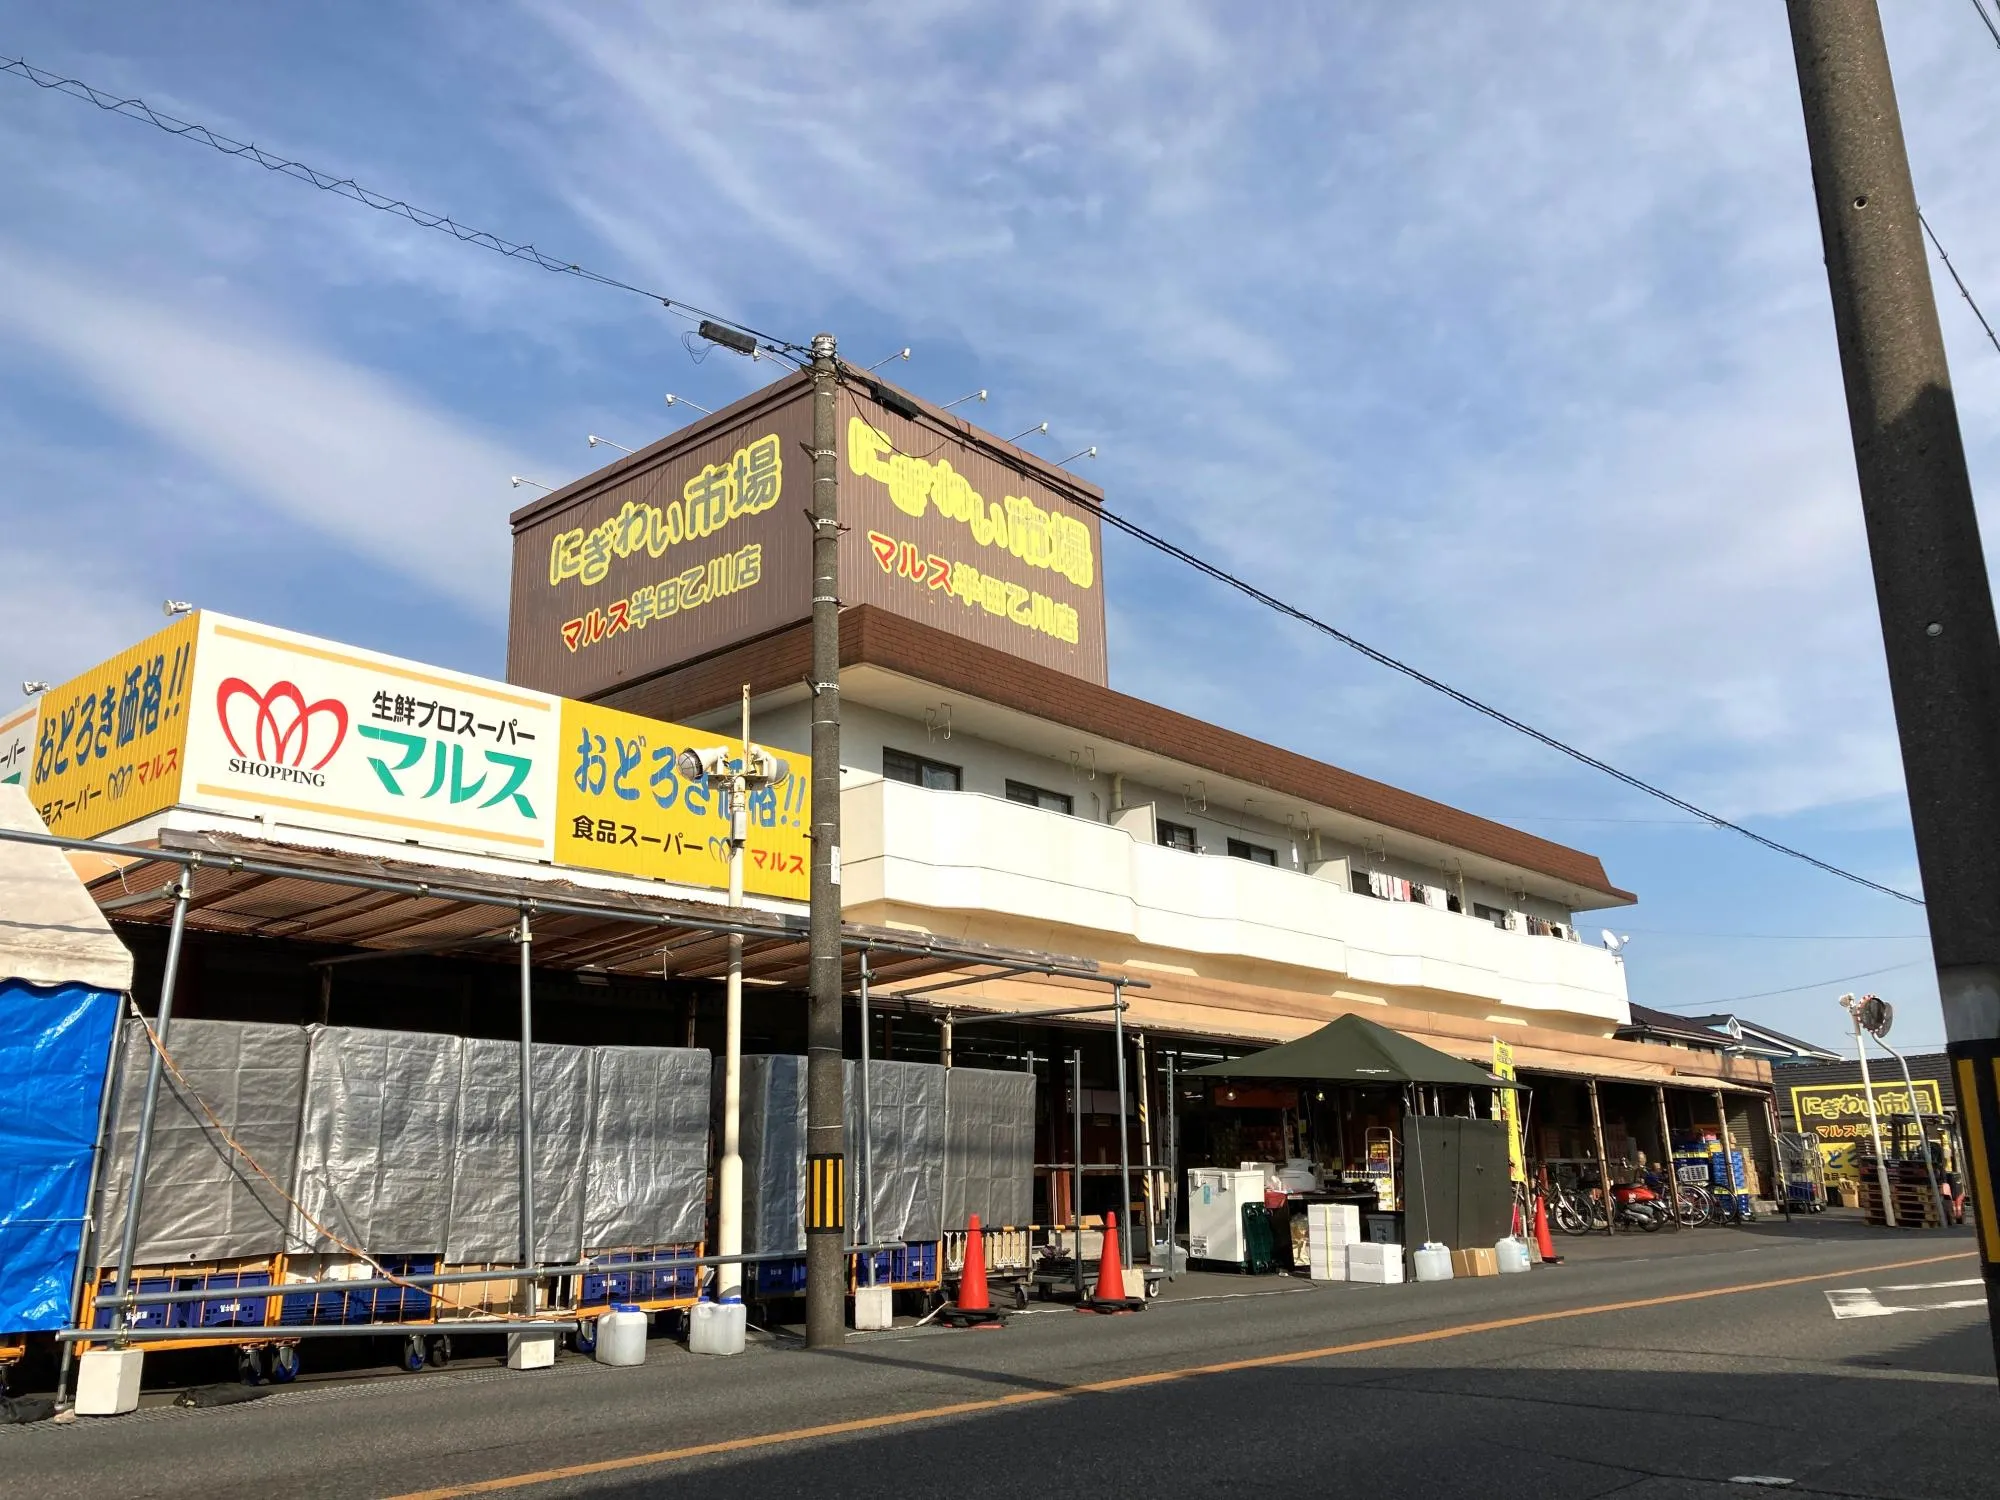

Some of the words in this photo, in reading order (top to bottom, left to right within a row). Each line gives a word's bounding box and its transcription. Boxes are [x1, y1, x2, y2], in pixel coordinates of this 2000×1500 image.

[550, 433, 782, 586] にぎわい市場
[848, 417, 1093, 589] にぎわい市場
[561, 544, 761, 652] マルス半田乙川店
[868, 530, 1078, 644] マルス半田乙川店
[35, 642, 190, 785] おどろき価格!!
[372, 690, 535, 745] 生鮮プロスーパー
[36, 784, 102, 827] 品スーパー
[138, 747, 178, 786] マルス
[228, 758, 326, 788] SHOPPING
[357, 724, 537, 819] マルス
[574, 727, 806, 827] おどろき格!!
[572, 815, 703, 855] 食品スーパー
[751, 849, 804, 875] マルス
[1802, 1091, 1933, 1119] にぎわい市場
